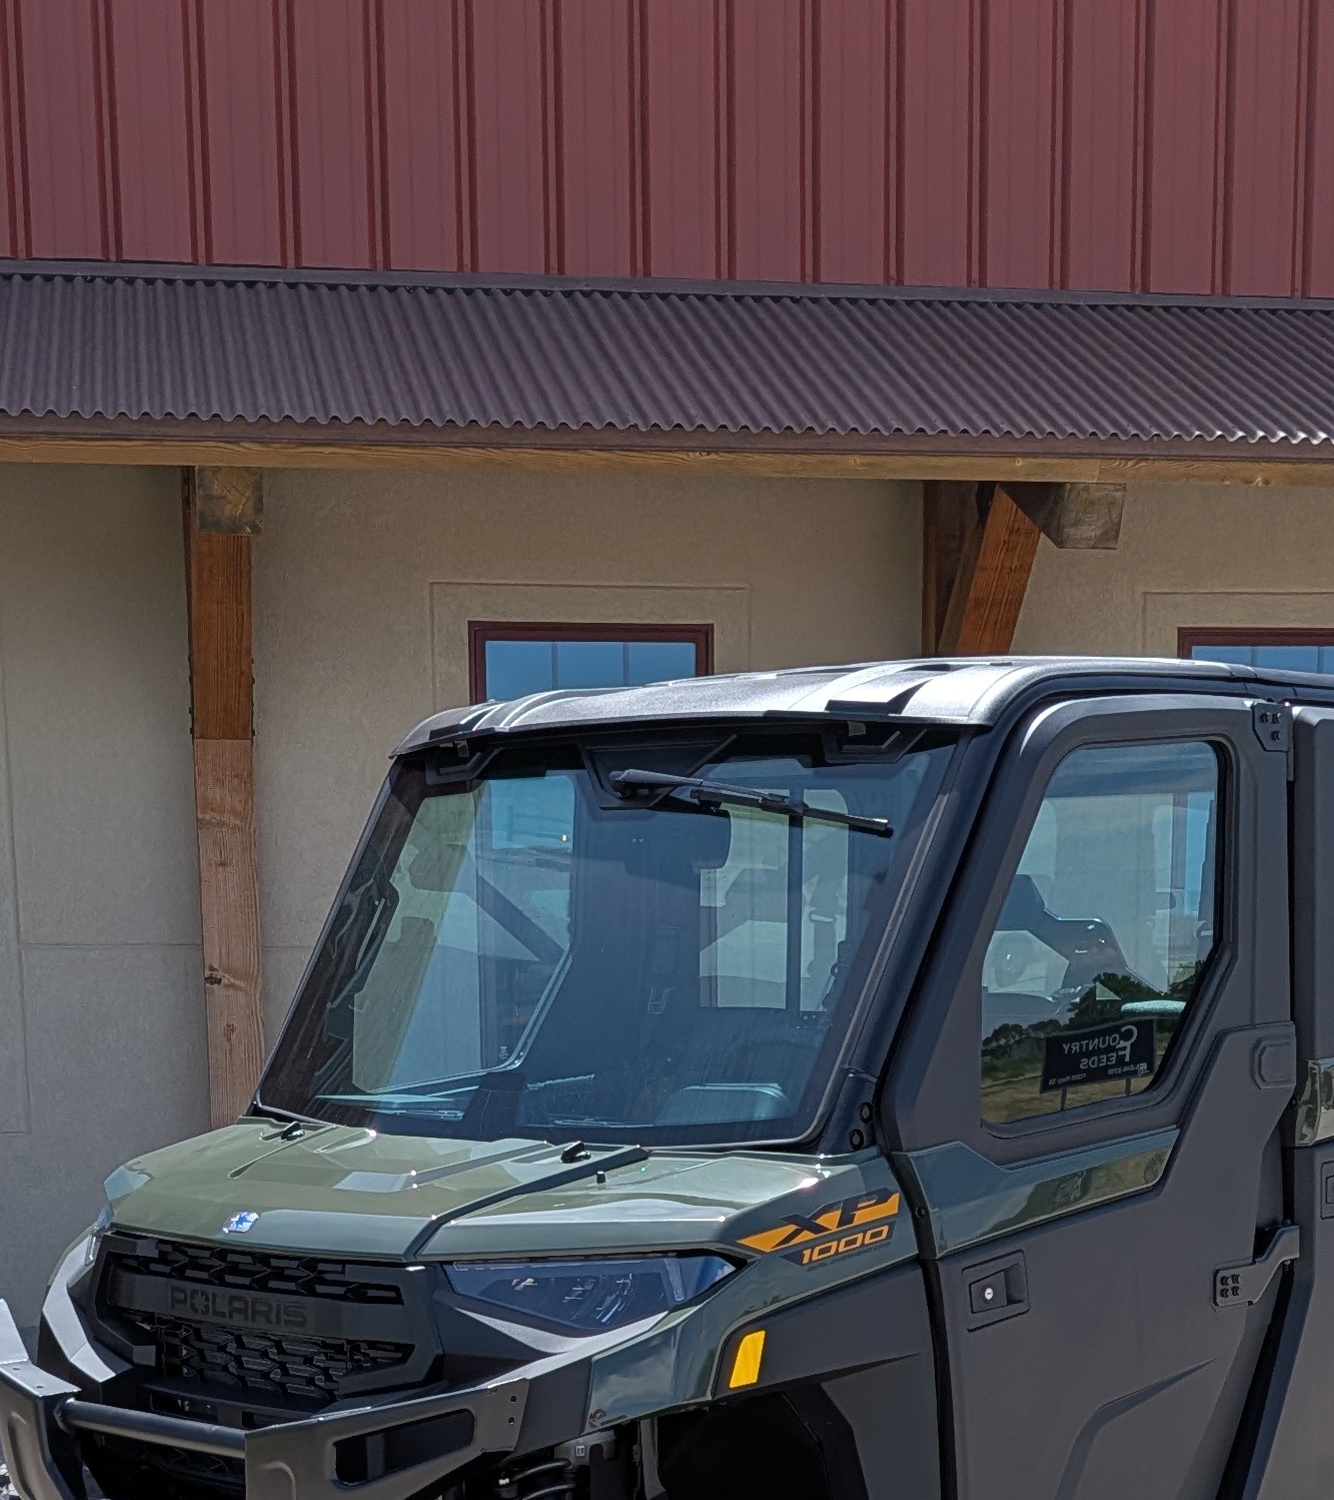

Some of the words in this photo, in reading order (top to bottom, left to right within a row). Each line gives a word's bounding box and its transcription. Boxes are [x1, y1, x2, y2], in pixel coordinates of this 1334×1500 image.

[770, 1187, 896, 1249] XP
[802, 1225, 890, 1265] 1000
[170, 1284, 307, 1328] POLARIS
